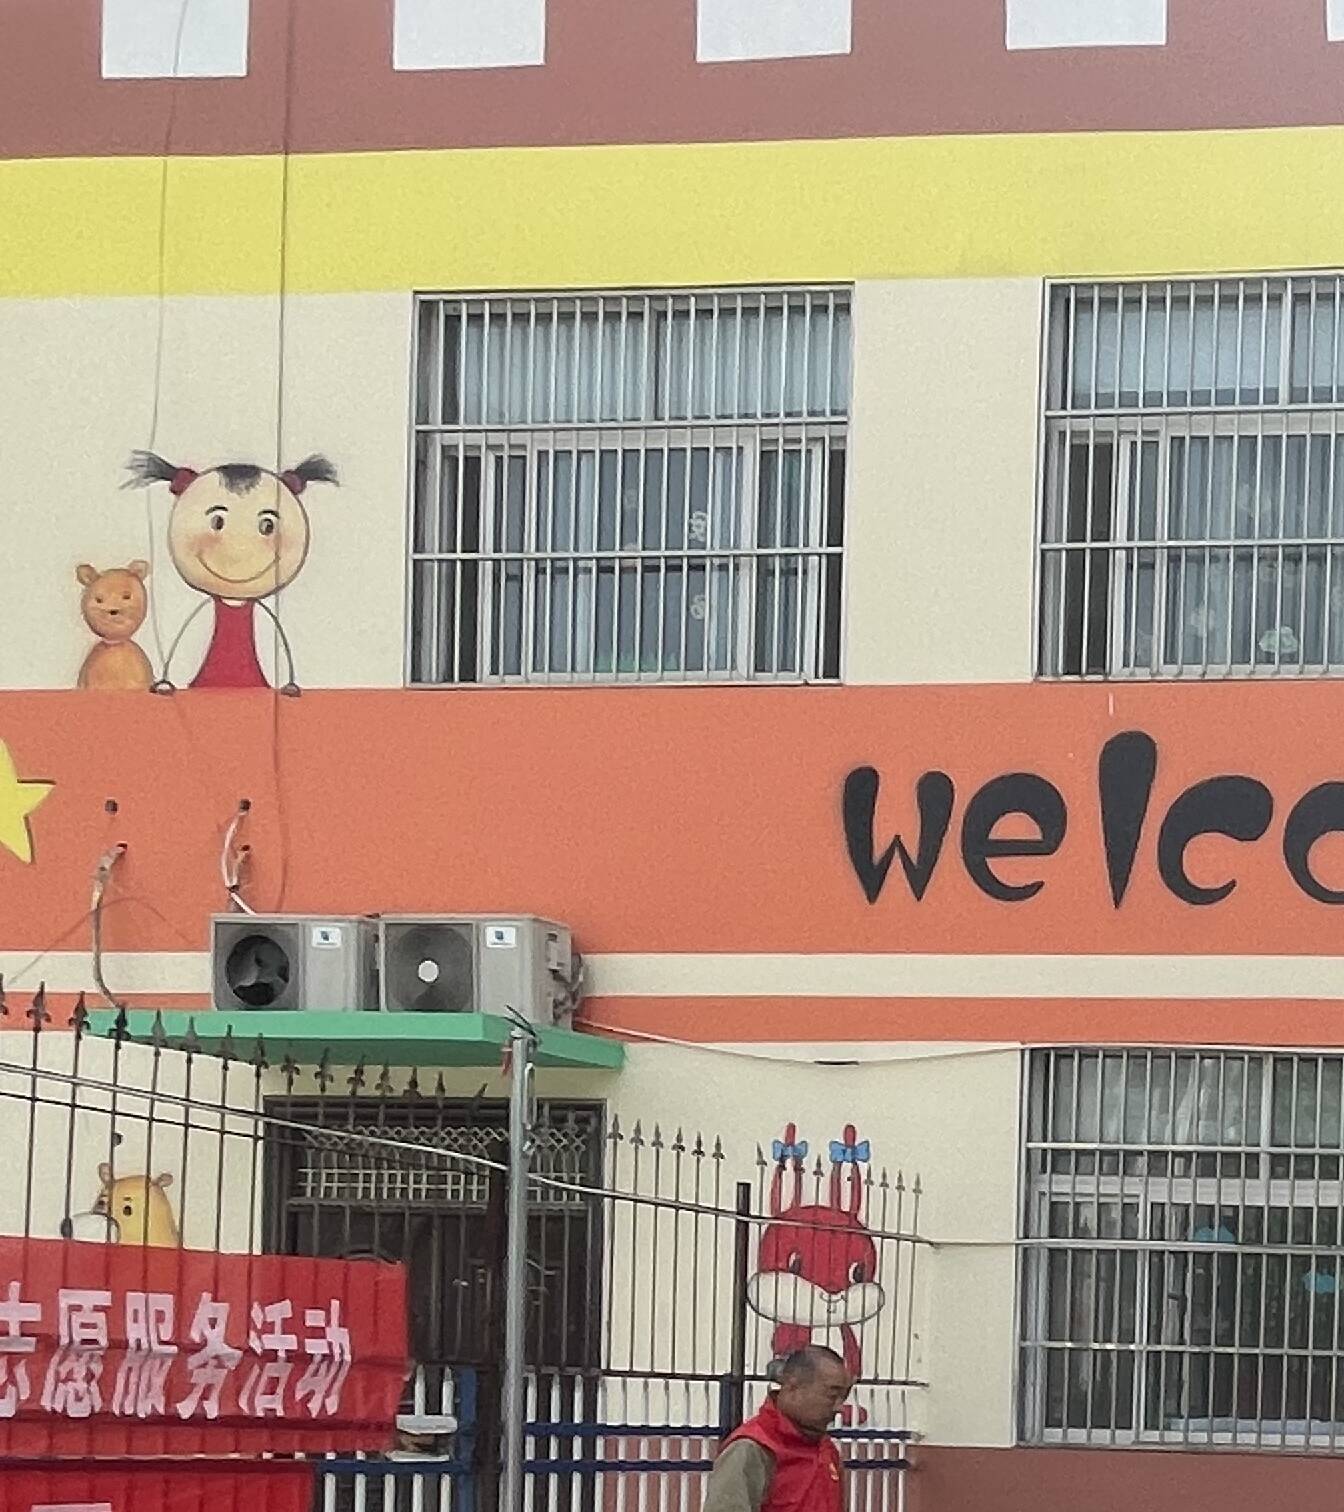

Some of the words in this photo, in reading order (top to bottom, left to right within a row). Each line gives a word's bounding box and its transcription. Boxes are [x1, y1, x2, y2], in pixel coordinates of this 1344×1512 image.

[0, 1281, 353, 1420] 志愿服务活动
